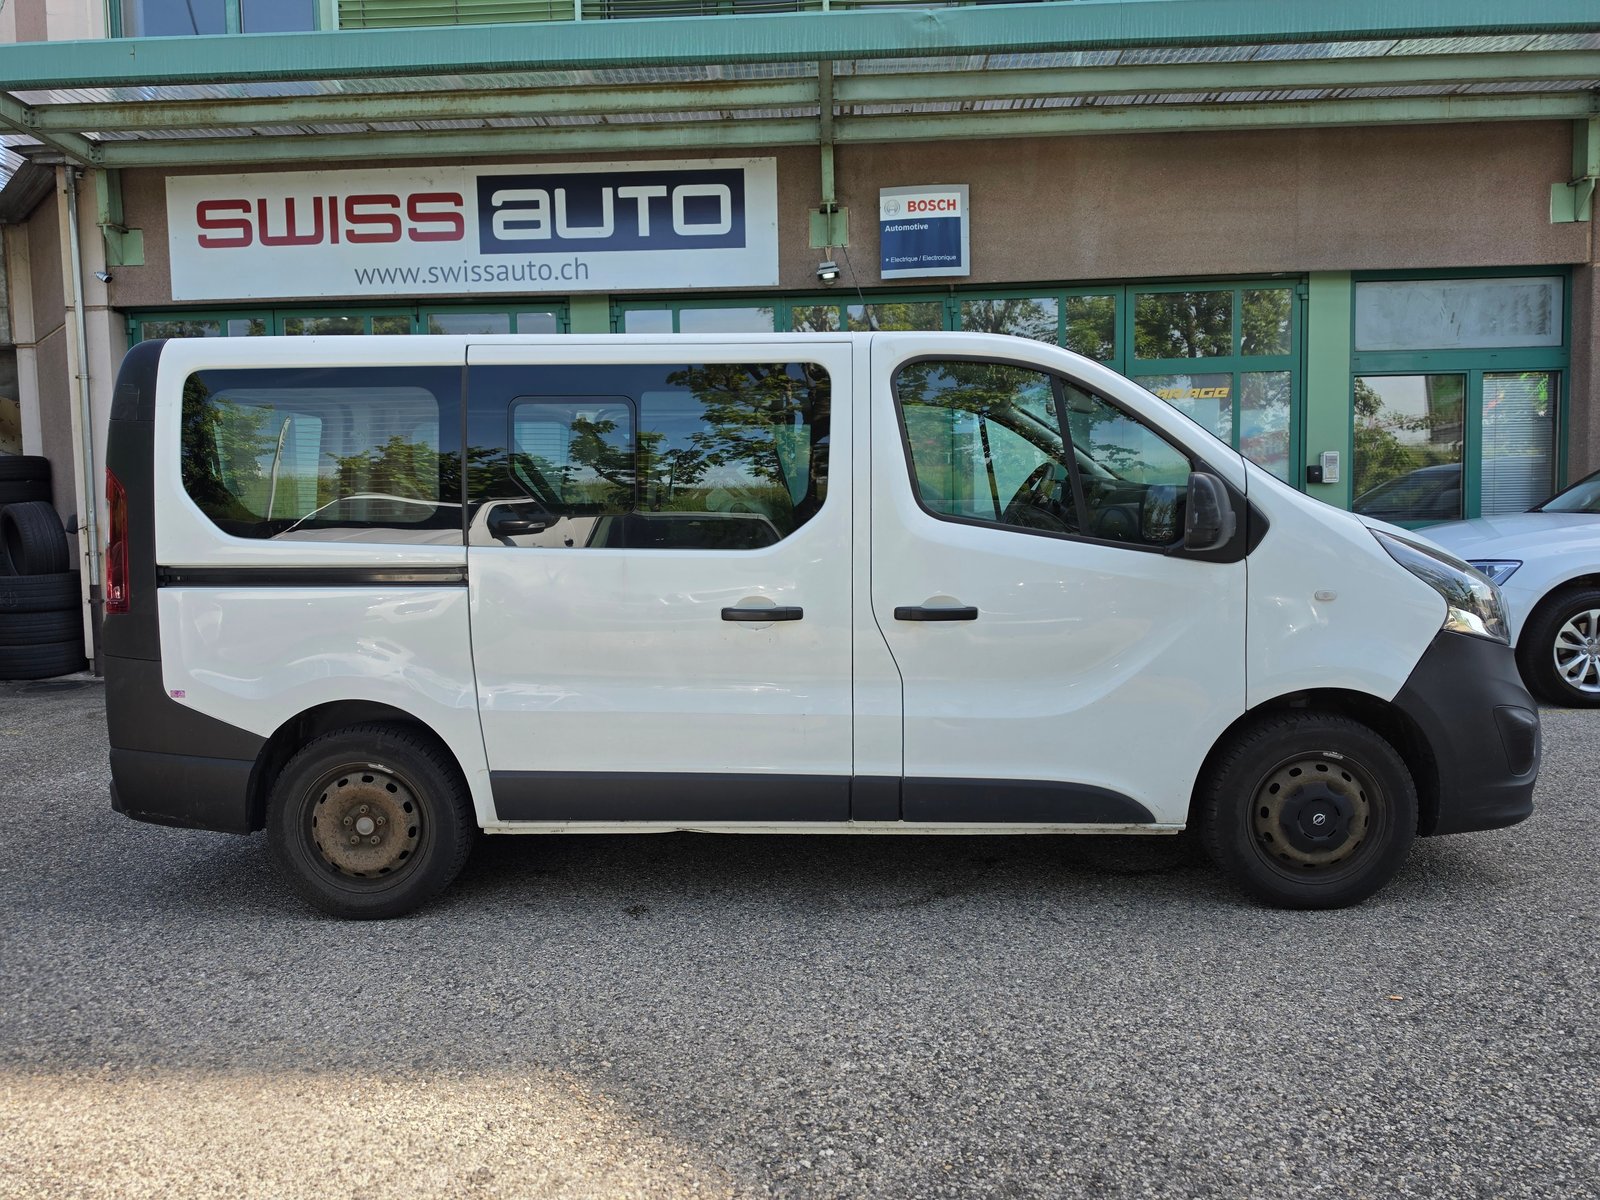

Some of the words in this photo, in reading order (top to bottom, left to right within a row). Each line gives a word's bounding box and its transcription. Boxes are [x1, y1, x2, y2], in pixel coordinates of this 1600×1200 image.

[907, 199, 957, 212] BOSCH
[196, 192, 465, 248] SWISS
[885, 223, 929, 232] Automotive
[890, 256, 918, 264] Electrique
[922, 254, 957, 262] Electronique
[354, 257, 589, 286] www.swissauto.ch
